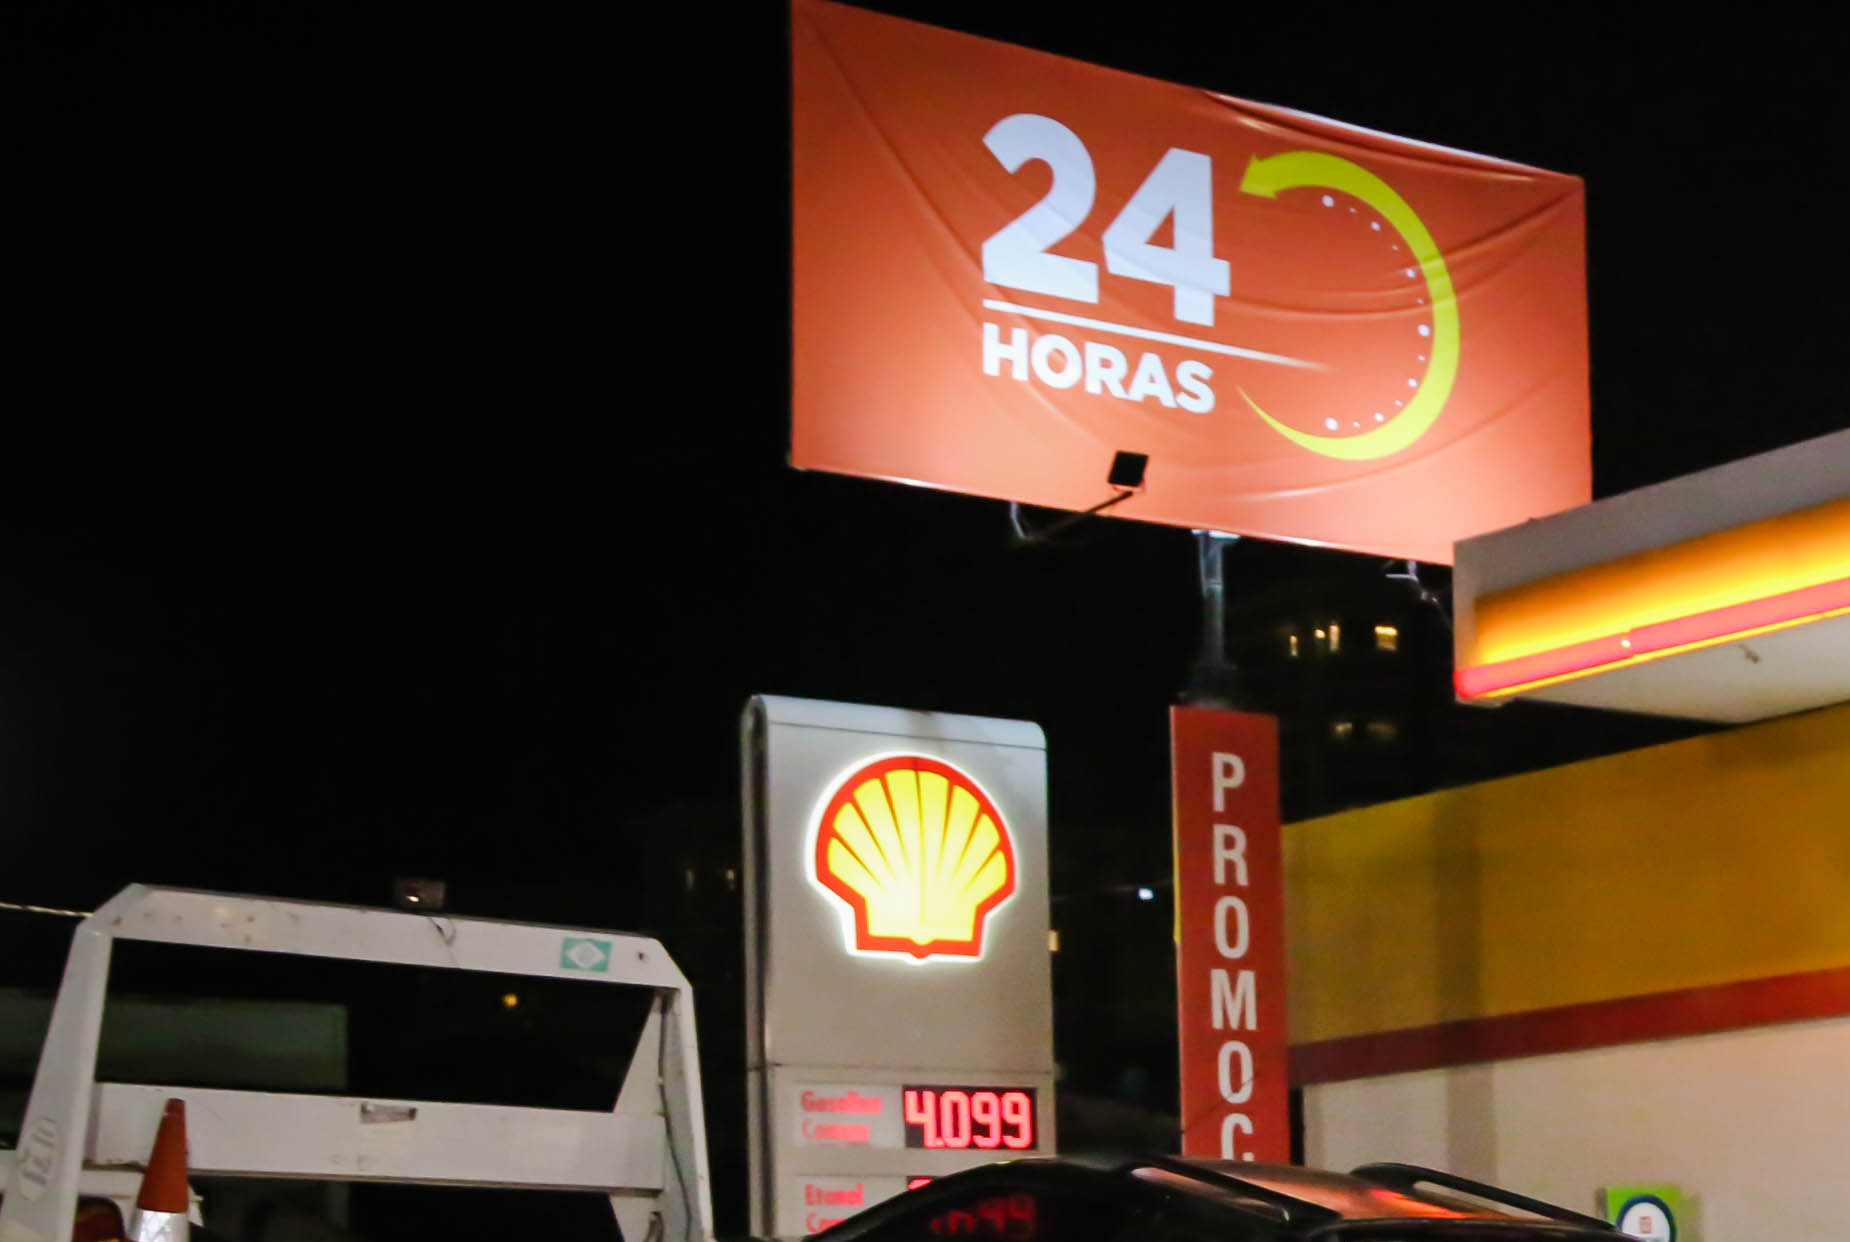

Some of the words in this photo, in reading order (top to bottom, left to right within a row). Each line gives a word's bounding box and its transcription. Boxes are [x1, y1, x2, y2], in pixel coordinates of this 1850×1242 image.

[981, 113, 1231, 328] 24
[982, 321, 1216, 414] HORAS
[1212, 752, 1256, 1162] PROMOC
[904, 1090, 1032, 1149] 4.099
